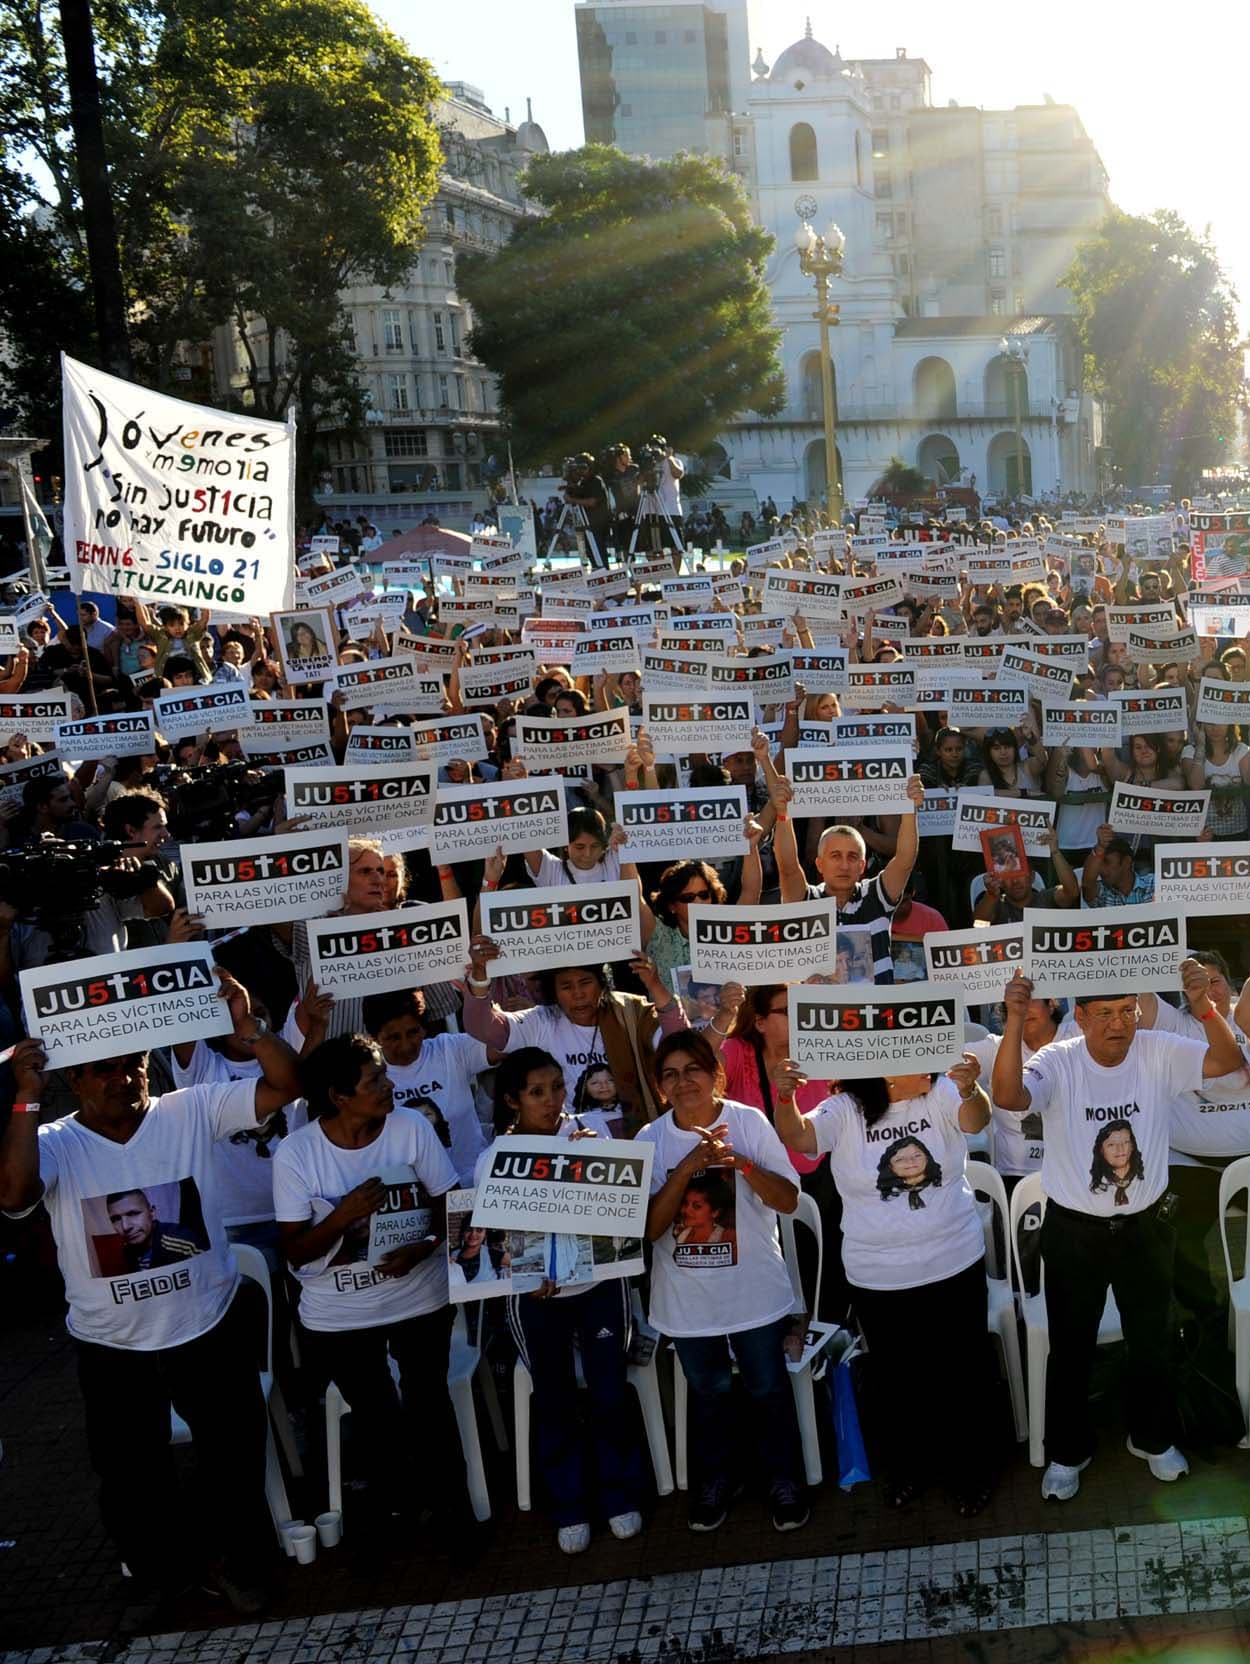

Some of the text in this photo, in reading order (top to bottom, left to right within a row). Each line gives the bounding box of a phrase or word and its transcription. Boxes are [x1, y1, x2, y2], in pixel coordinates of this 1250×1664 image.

[152, 454, 269, 482] memoria
[129, 511, 166, 535] hay
[232, 558, 260, 581] 21
[111, 568, 245, 603] ITUZAINGÓ
[435, 828, 465, 840] PARA
[468, 825, 490, 836] LAS
[546, 817, 560, 827] DE
[435, 827, 560, 851] LA TRAGEDIA DE ONCE
[1031, 959, 1064, 970] PARA
[1067, 958, 1091, 969] LAS
[1161, 951, 1178, 962] DE
[1031, 964, 1178, 983] LA TRAGEDIA DE ONCE
[40, 1018, 83, 1037] PARA
[85, 1012, 116, 1028] LAS
[195, 994, 216, 1007] DE
[42, 1007, 218, 1050] LA TRAGEDIA DE ONCE
[798, 1038, 836, 1048] PARA
[839, 1037, 866, 1048] LAS
[938, 1031, 955, 1043] DE
[798, 1044, 954, 1061] LA TRAGEDIA DE ONCE
[1085, 1101, 1141, 1122] MONICA
[866, 1117, 932, 1143] MONICA
[486, 1185, 522, 1197] PARA
[523, 1187, 550, 1199] LAS
[620, 1193, 639, 1205] DE
[483, 1198, 500, 1209] LA
[500, 1199, 571, 1214] TRAGEDIA
[573, 1204, 593, 1215] DE
[596, 1205, 637, 1218] ONCE
[110, 1268, 192, 1305] FEDE
